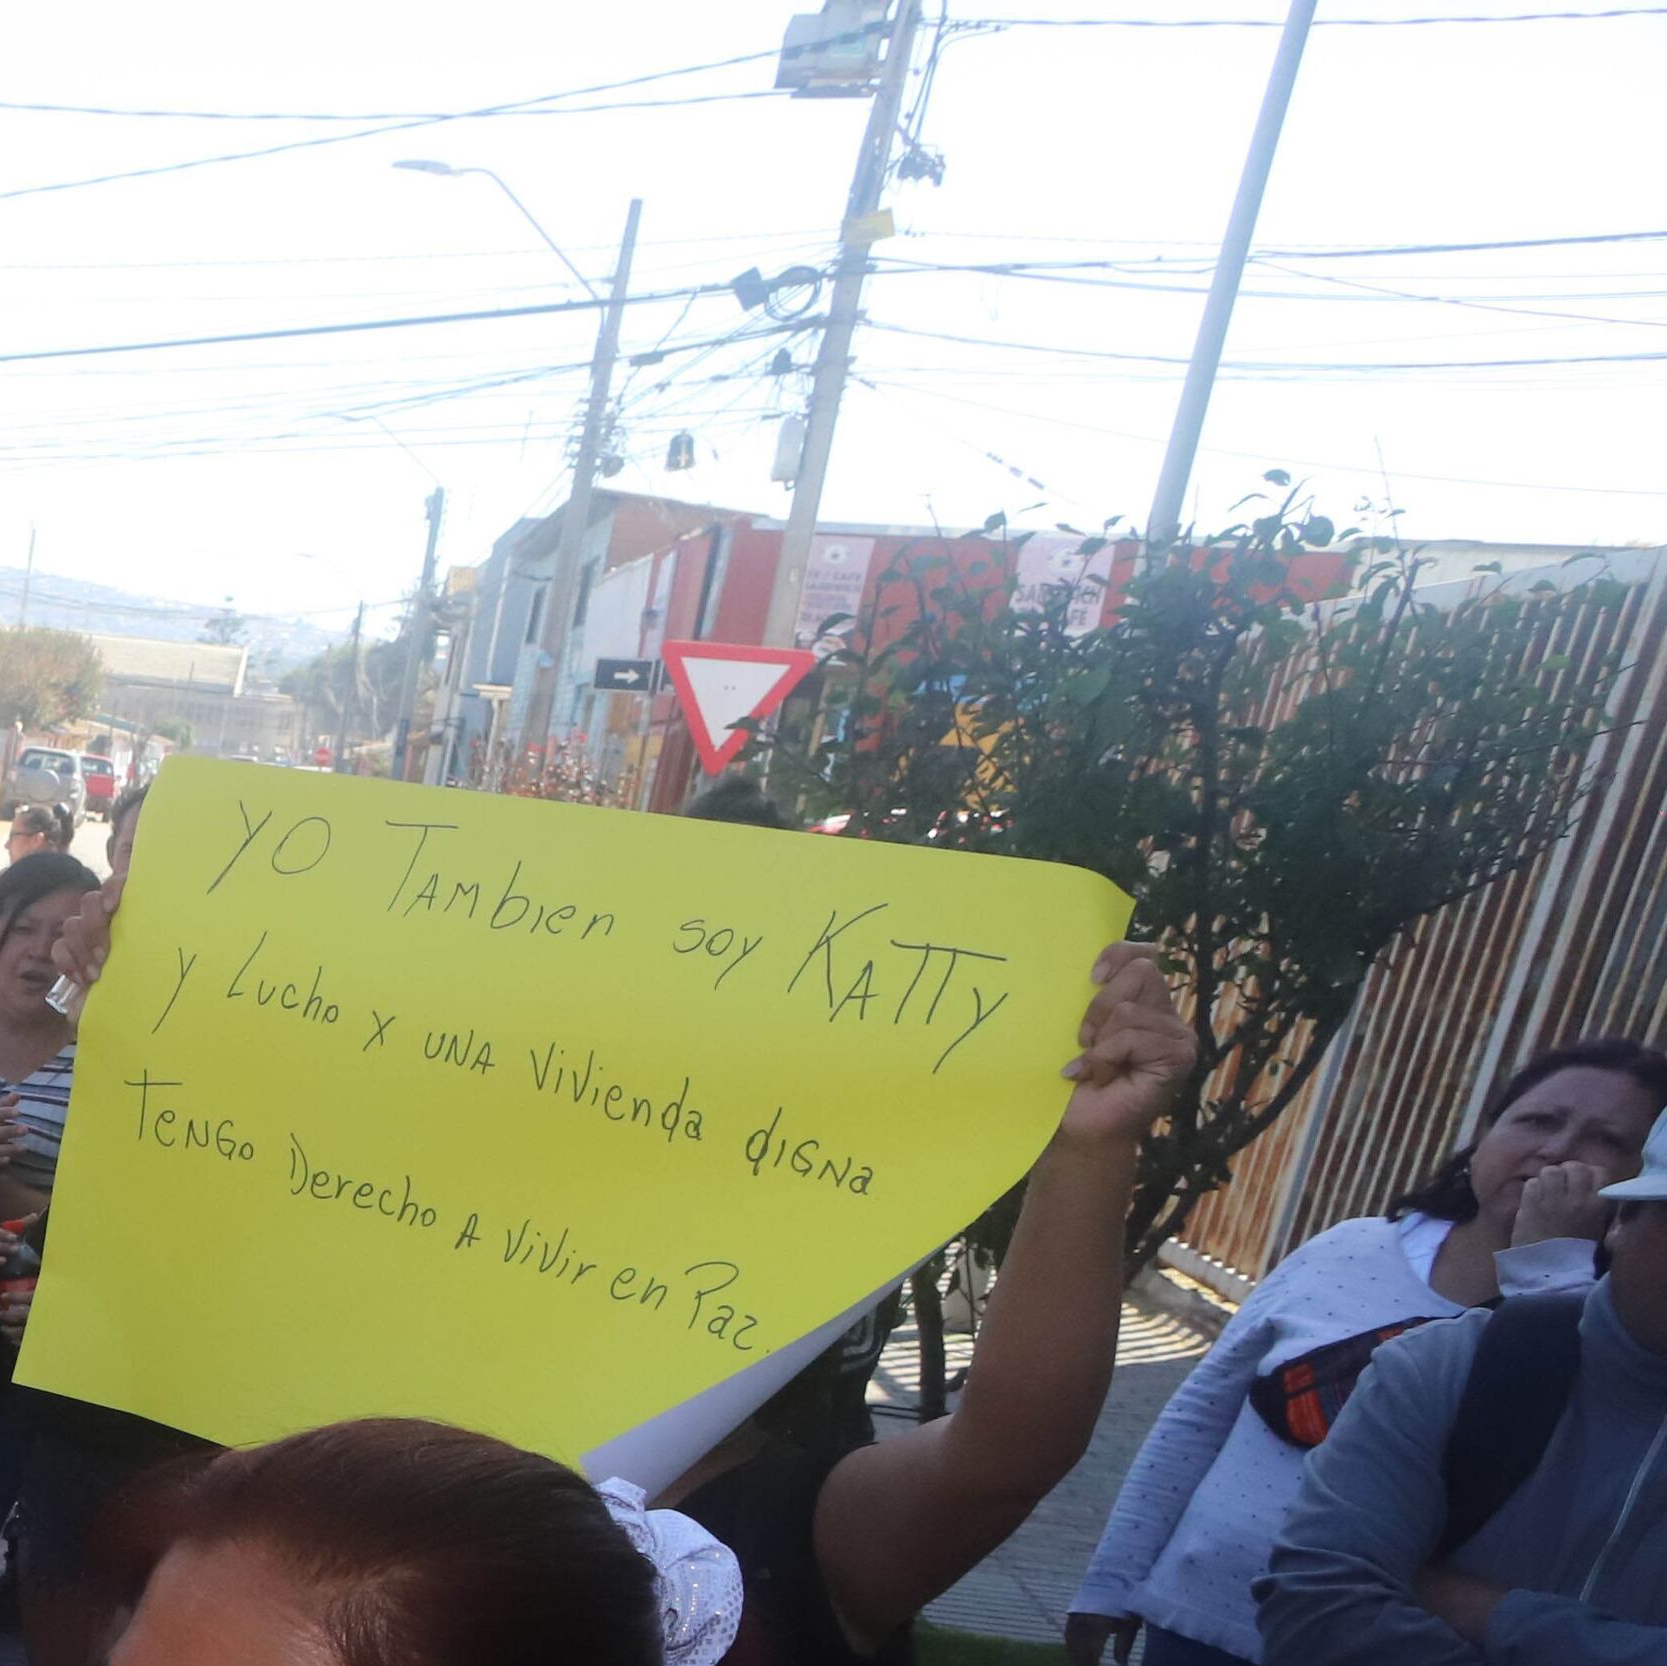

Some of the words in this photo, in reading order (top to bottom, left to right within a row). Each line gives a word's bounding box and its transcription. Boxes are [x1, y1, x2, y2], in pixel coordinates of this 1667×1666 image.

[673, 914, 763, 991] soy
[226, 932, 340, 1024] Lucho
[423, 1029, 496, 1075] UNA
[454, 1212, 482, 1251] A
[609, 1266, 668, 1311] en
